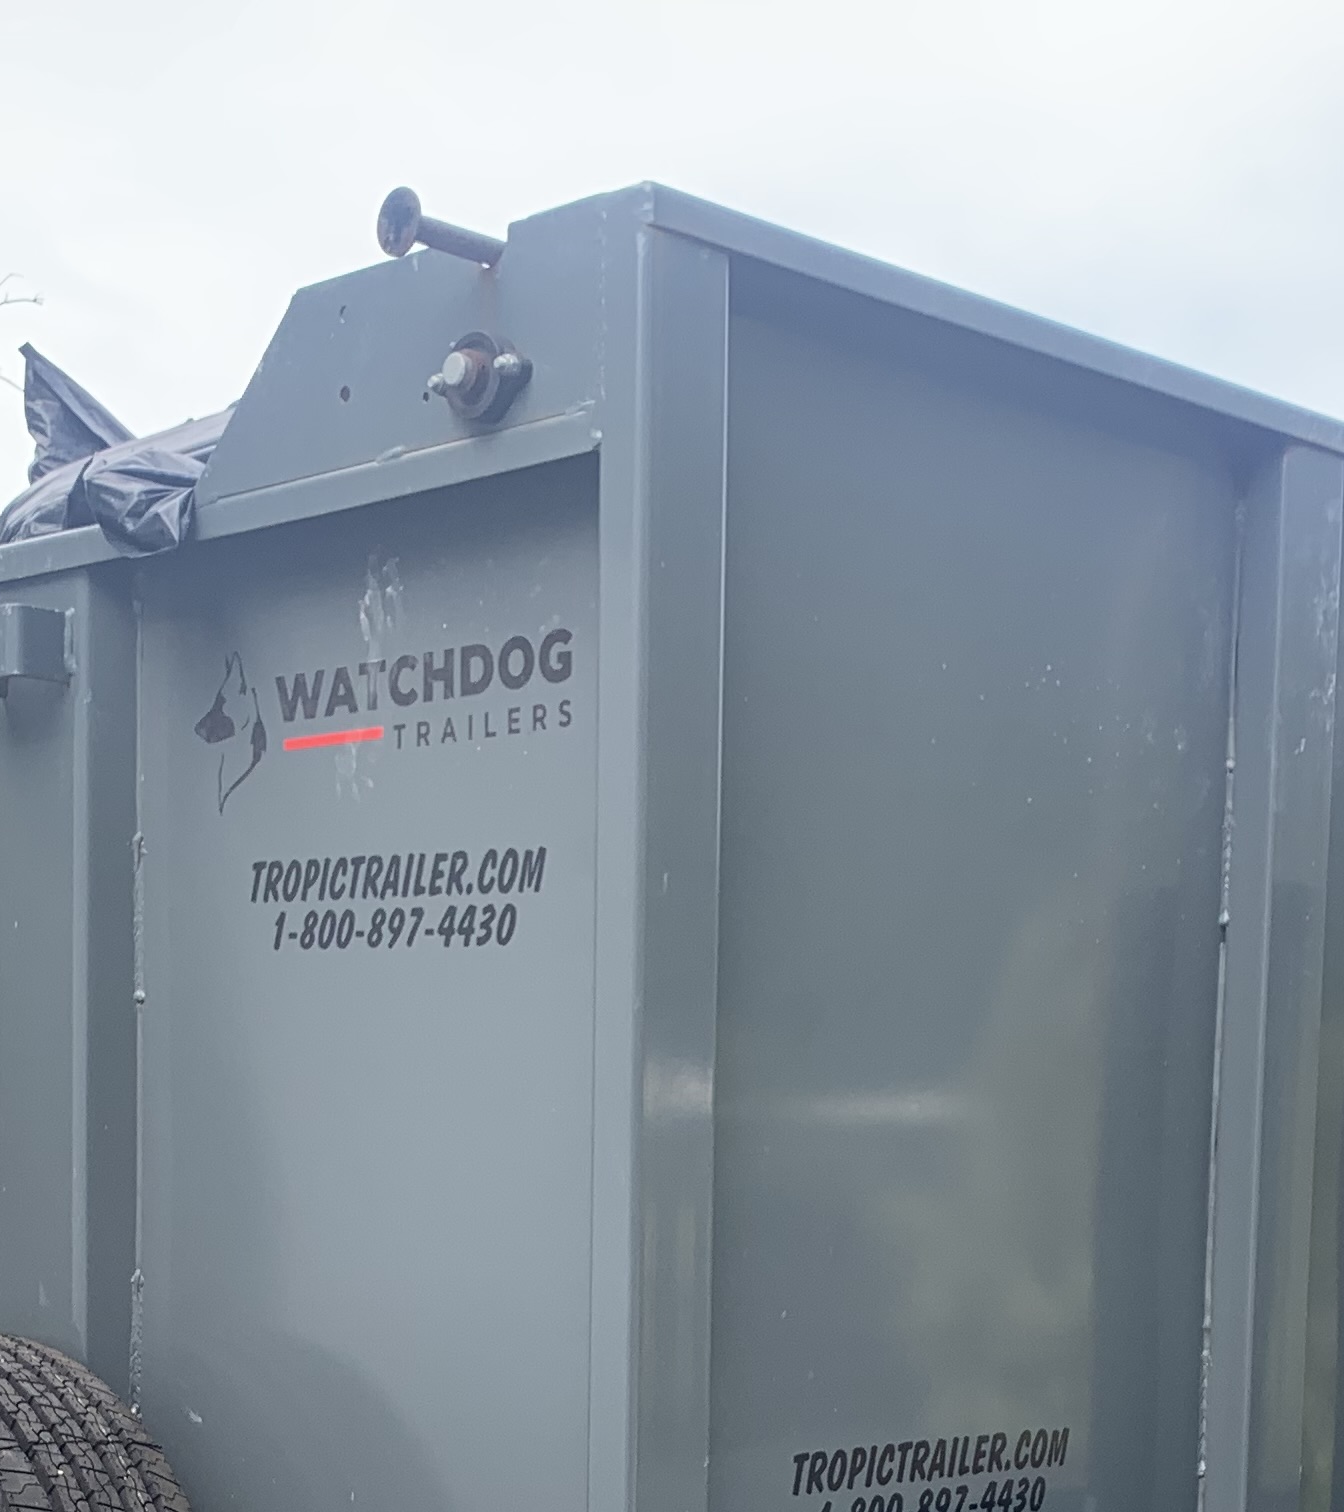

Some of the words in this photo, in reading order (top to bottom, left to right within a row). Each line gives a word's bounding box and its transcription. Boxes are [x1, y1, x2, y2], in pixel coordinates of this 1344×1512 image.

[275, 628, 573, 722] WATCHDOG
[393, 700, 572, 750] TRAILERS
[250, 846, 547, 903] TROPICTRAILER.COM
[273, 903, 517, 951] 1-800-897-4430
[792, 1427, 1071, 1497] TROPICTRAILER.COM
